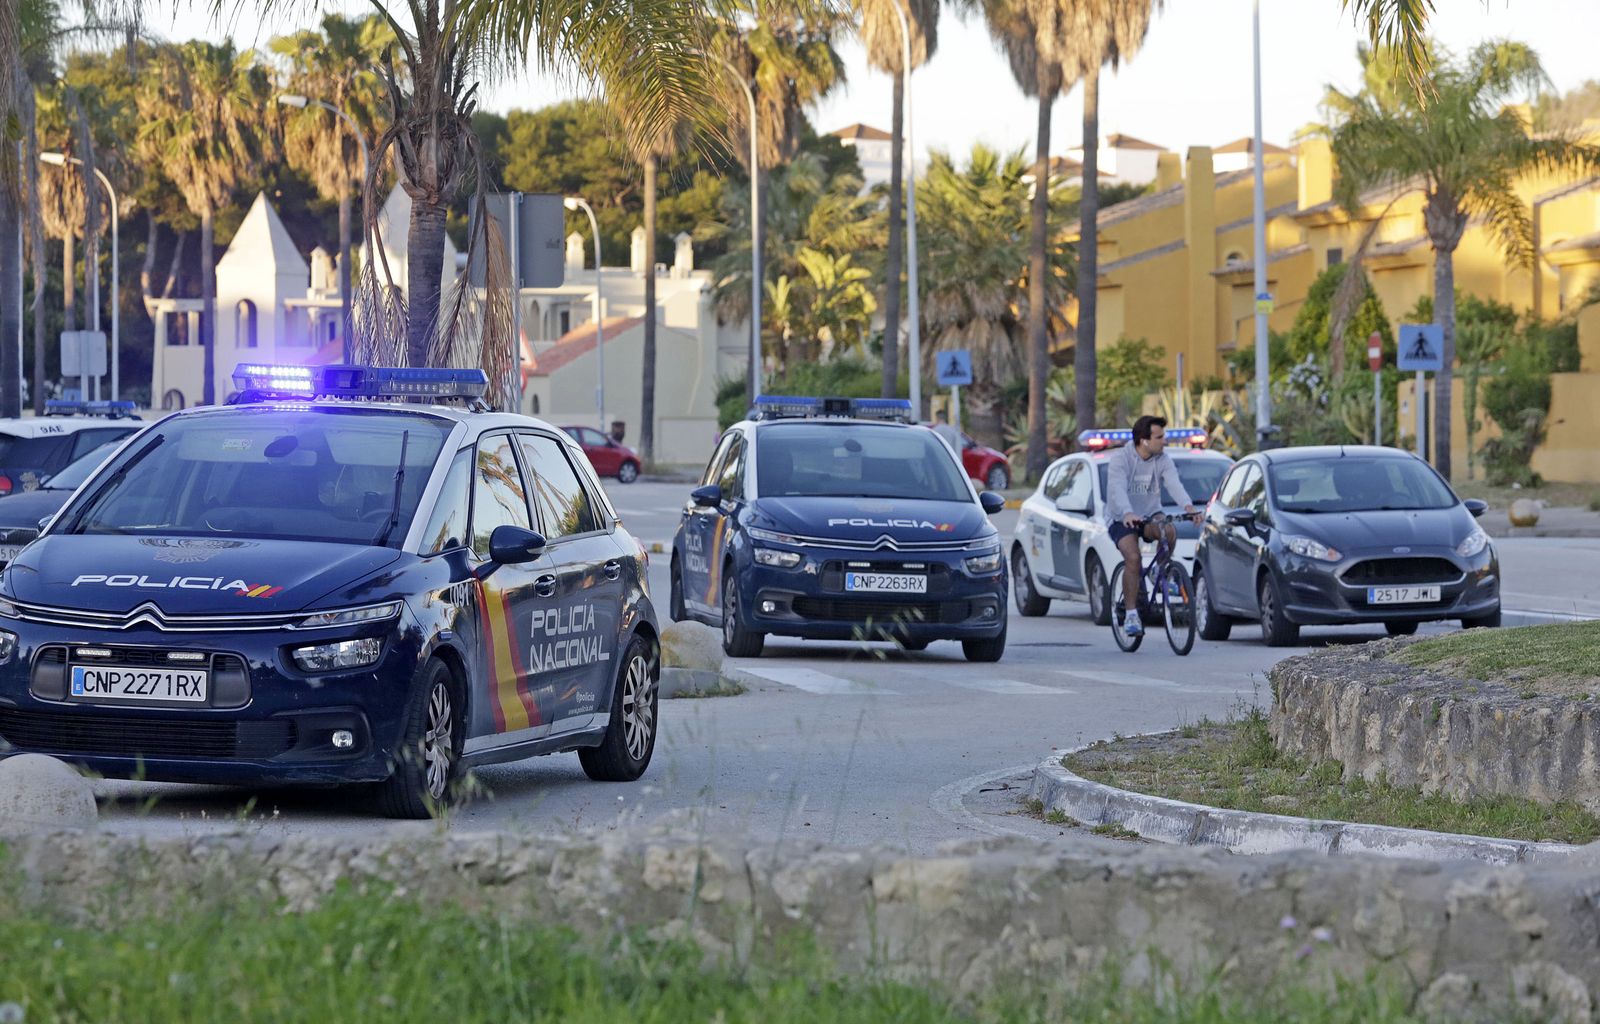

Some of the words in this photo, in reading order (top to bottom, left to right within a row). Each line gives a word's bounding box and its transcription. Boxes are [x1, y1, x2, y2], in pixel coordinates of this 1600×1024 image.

[71, 574, 250, 592] POLICÍA
[1377, 589, 1409, 602] 2517
[1413, 588, 1437, 600] JWL
[529, 634, 610, 673] NACIONAL
[83, 670, 203, 697] CNP2271RX
